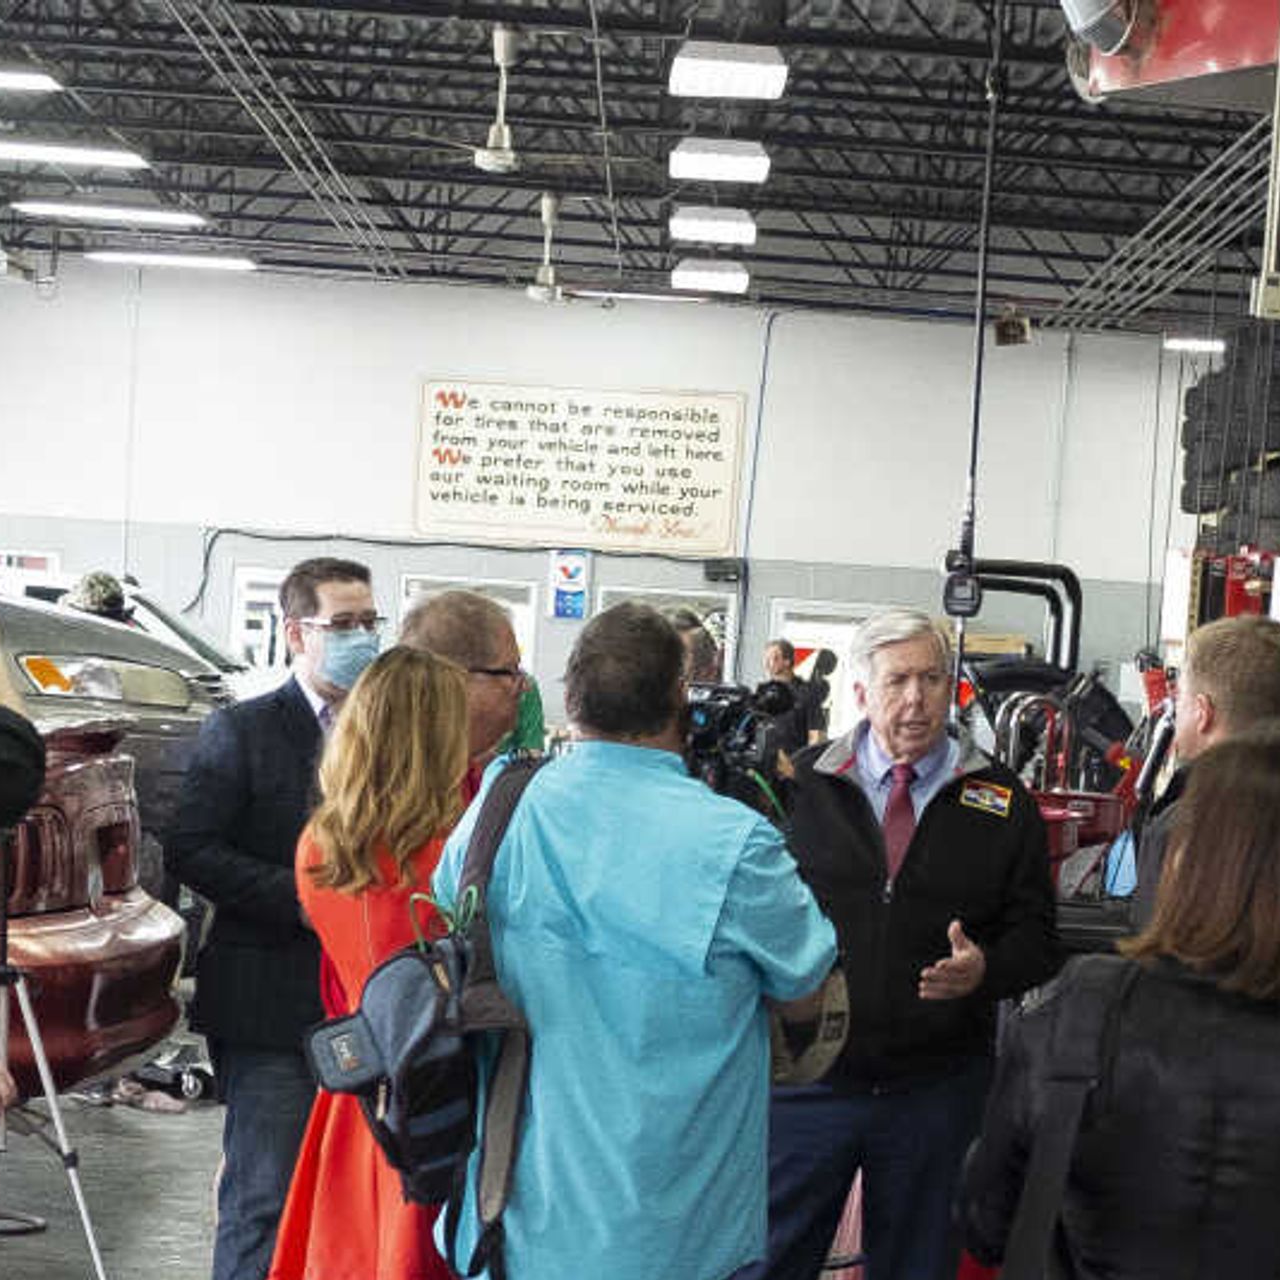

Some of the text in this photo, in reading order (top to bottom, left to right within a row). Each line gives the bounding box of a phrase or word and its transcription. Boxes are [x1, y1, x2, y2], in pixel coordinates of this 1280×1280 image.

[436, 389, 719, 423] We cannot be responsible
[434, 411, 720, 443] for tires that are removed
[433, 429, 478, 447] from
[488, 436, 528, 451] your
[538, 436, 599, 454] vehicle
[606, 441, 641, 457] and
[647, 441, 676, 460] left
[432, 448, 693, 480] We prefer that you use
[429, 471, 721, 501] our waiting room while your
[429, 486, 699, 518] vehicle is being serviced.
